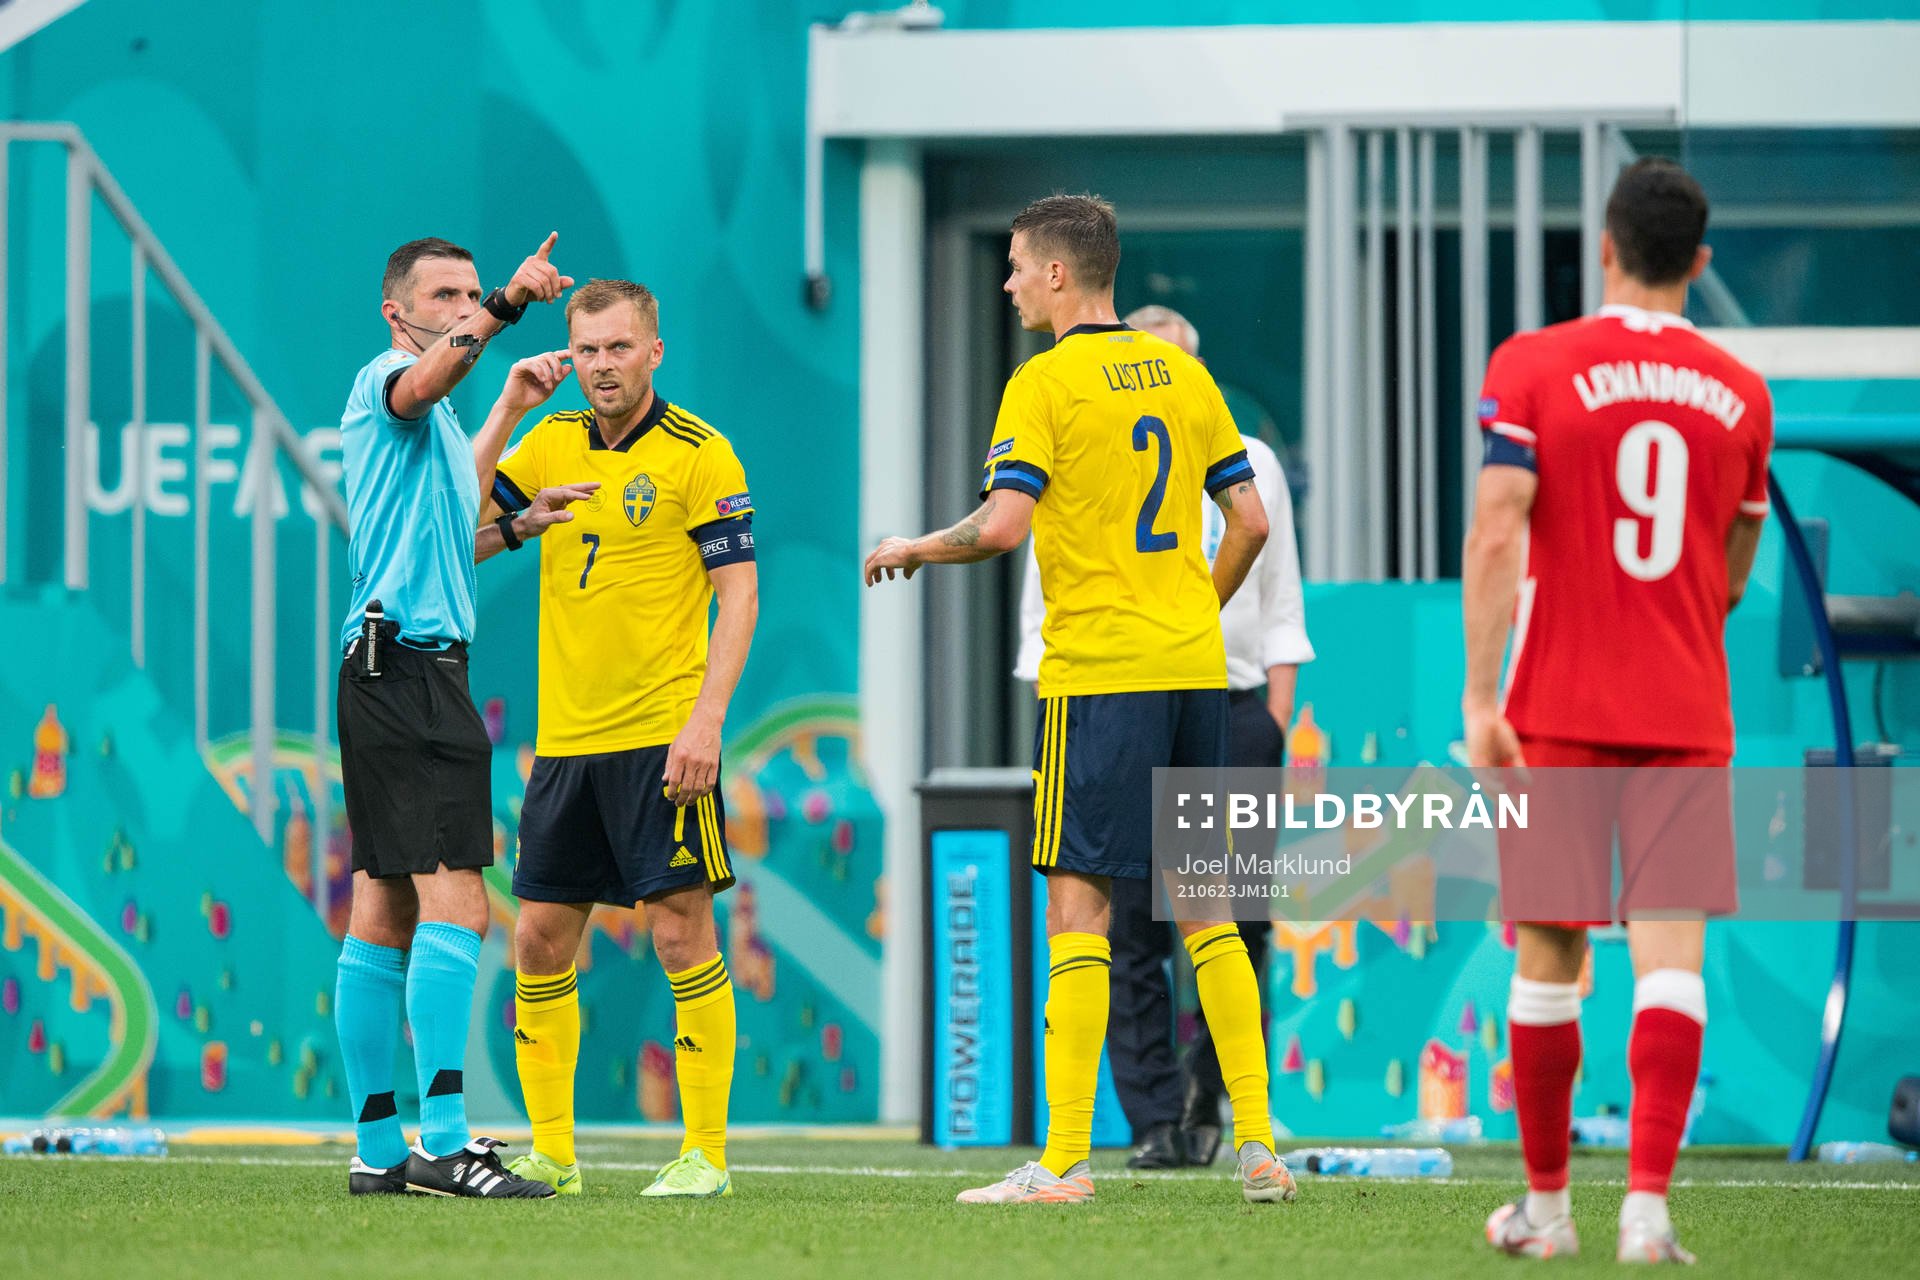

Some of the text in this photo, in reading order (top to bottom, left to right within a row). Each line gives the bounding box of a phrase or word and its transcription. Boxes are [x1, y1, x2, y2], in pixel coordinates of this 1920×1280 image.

[1102, 359, 1172, 391] LUSTIG
[1572, 360, 1746, 431] LEWANDOWSKI
[84, 421, 289, 518] UEFA
[1132, 415, 1178, 553] 2
[1613, 420, 1689, 582] 9
[580, 533, 600, 589] 7
[701, 540, 729, 556] SPECT
[368, 622, 377, 640] SPRAY
[669, 856, 698, 868] adidas
[947, 873, 979, 1138] POWERADE
